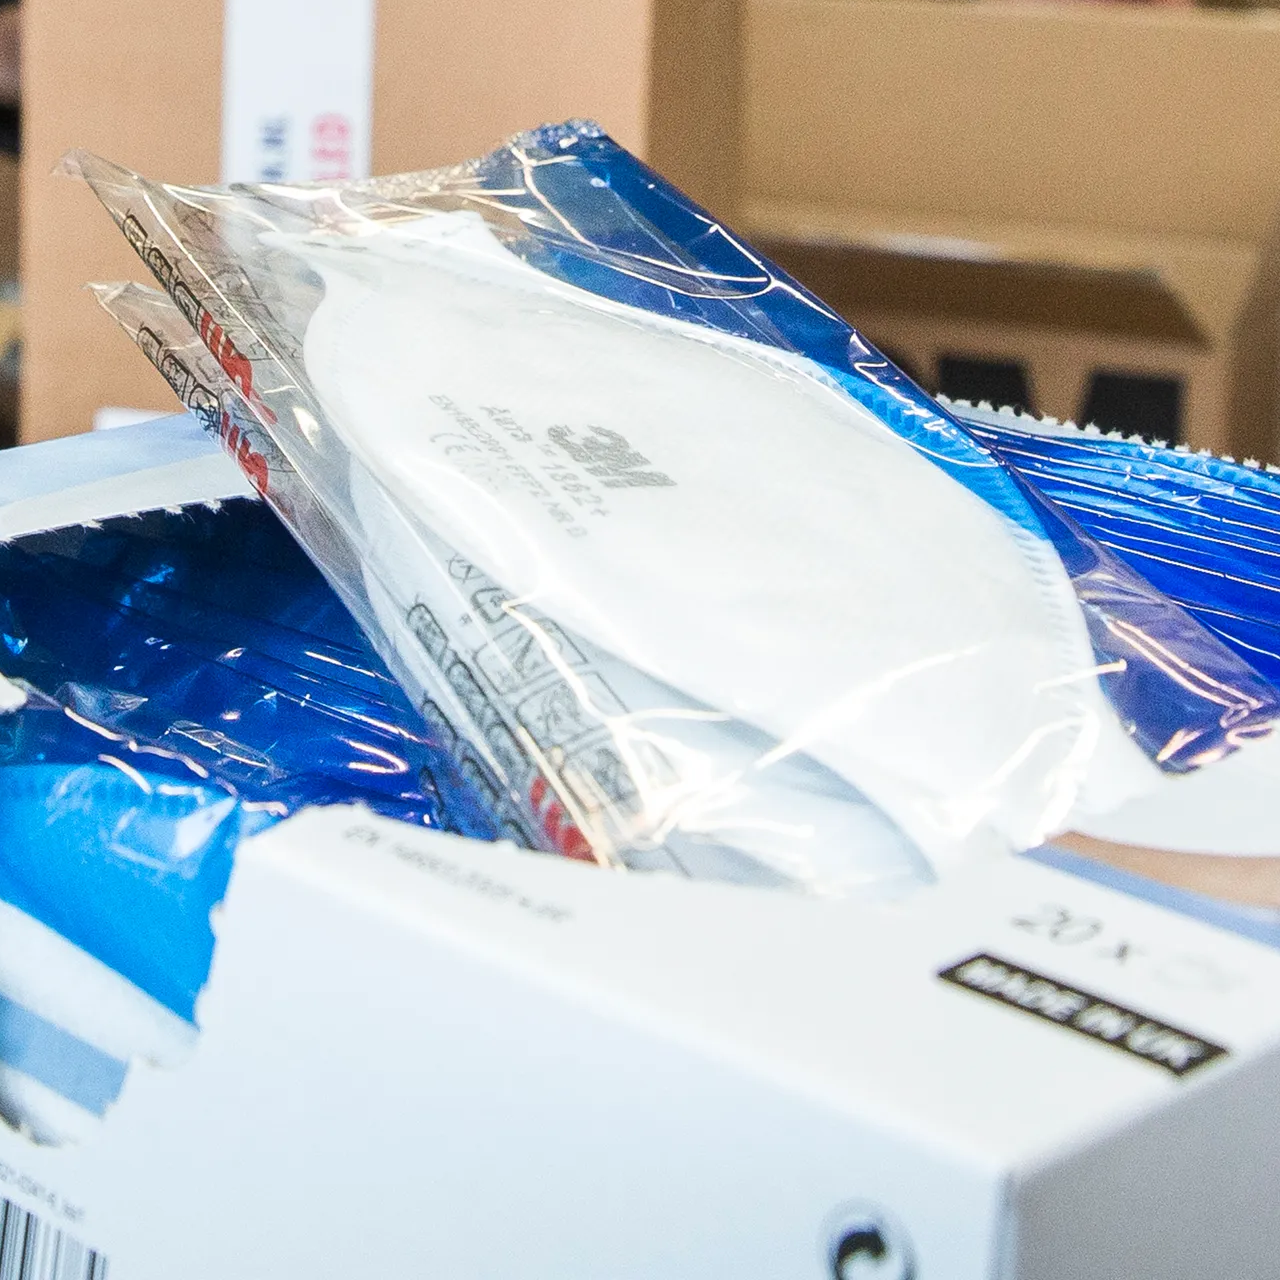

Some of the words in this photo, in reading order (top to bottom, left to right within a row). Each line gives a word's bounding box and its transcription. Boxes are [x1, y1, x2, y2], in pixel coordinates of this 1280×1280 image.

[547, 423, 677, 488] 3M
[955, 958, 1090, 1022] MADE
[1071, 1003, 1136, 1041] IN
[1124, 1021, 1205, 1070] UK
